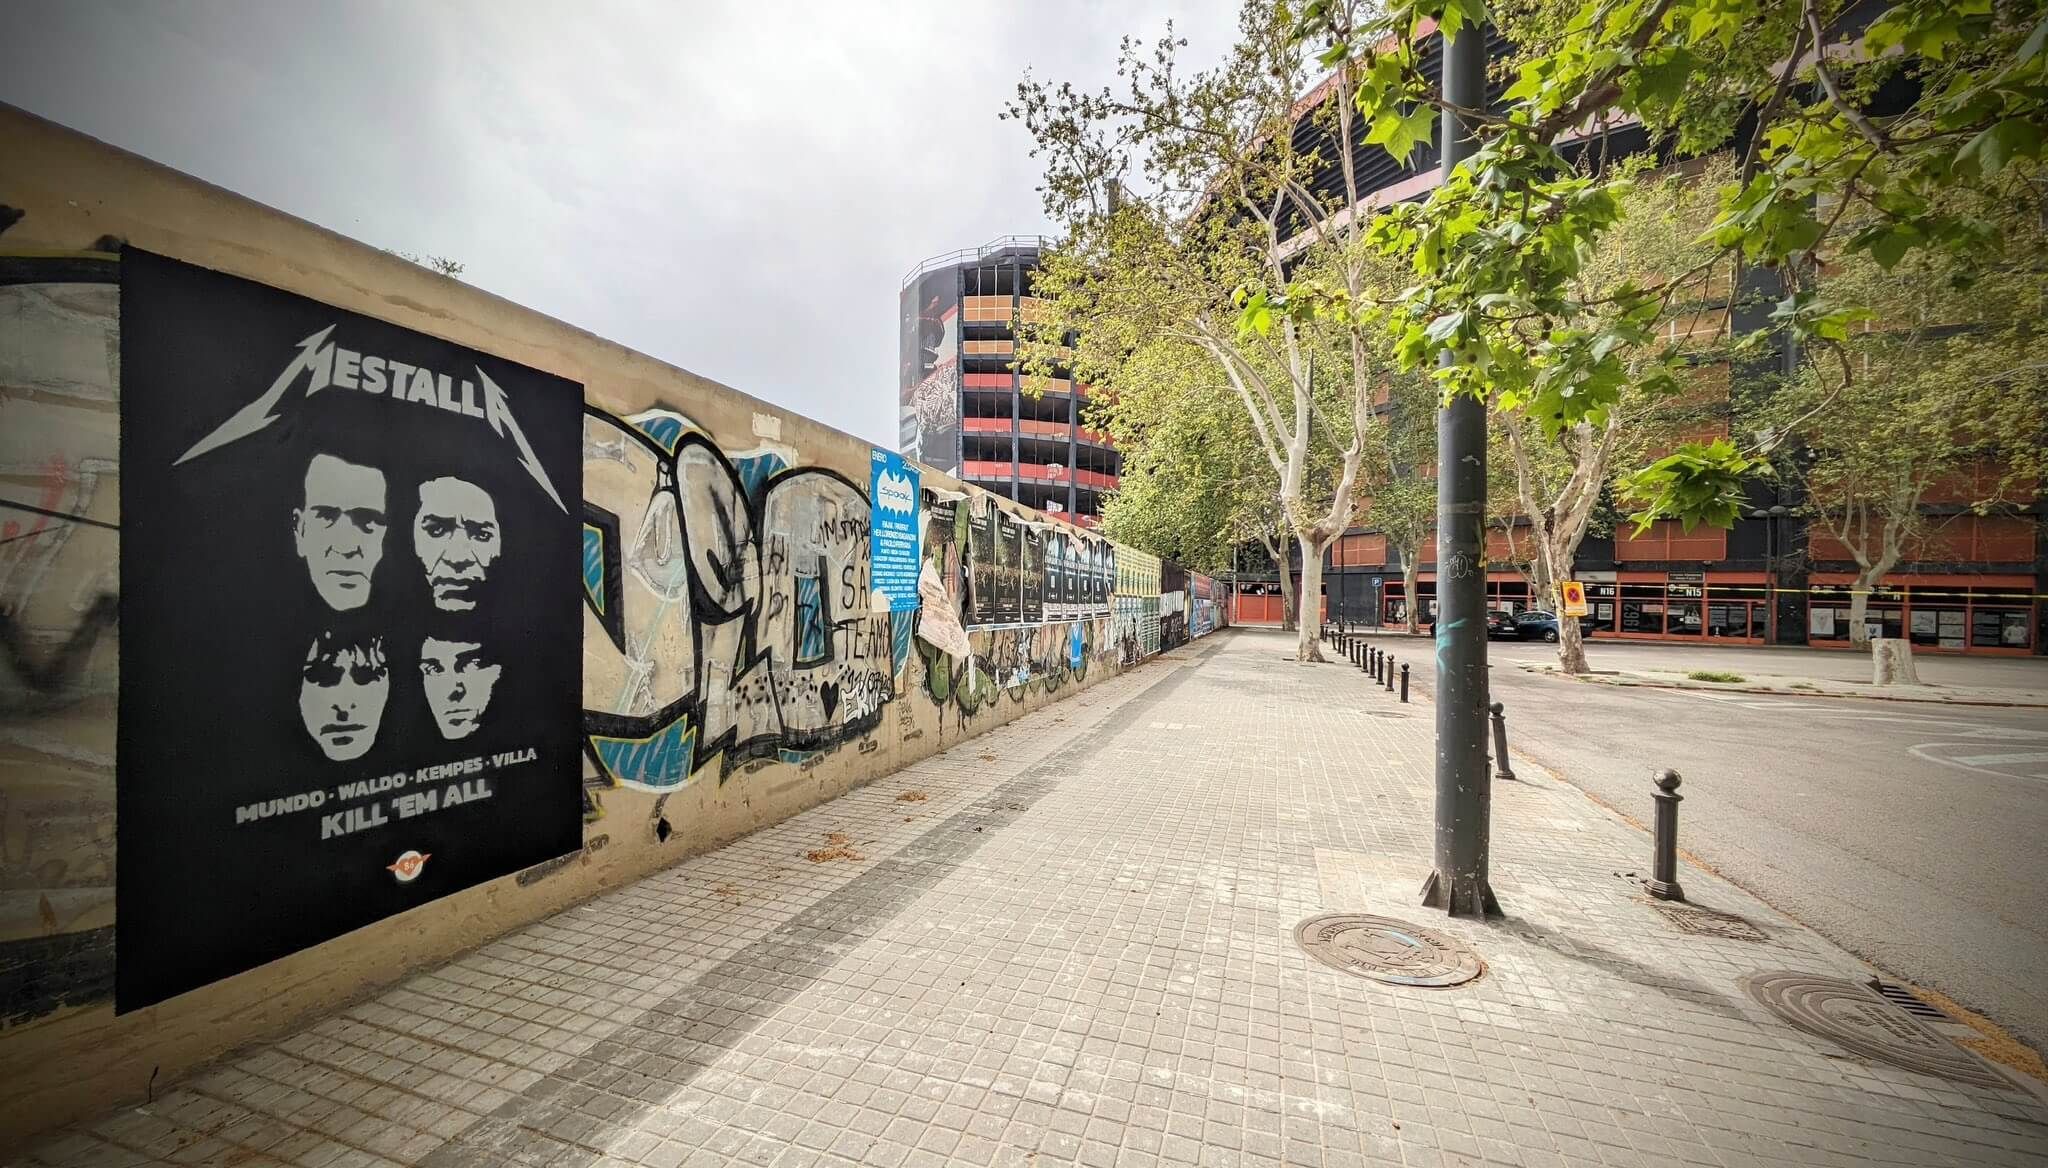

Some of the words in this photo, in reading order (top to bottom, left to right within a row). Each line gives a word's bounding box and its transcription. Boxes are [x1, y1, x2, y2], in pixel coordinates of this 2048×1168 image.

[173, 324, 569, 515] MESTALLA
[1600, 587, 1615, 596] N16
[1686, 587, 1702, 597] N15
[236, 790, 326, 825] MUNDO
[338, 772, 407, 801] WALDO
[415, 756, 484, 784] KEMPES
[491, 747, 537, 768] VILLA
[321, 803, 388, 840] KILL
[391, 789, 438, 819] 'EM
[442, 778, 493, 808] ALL
